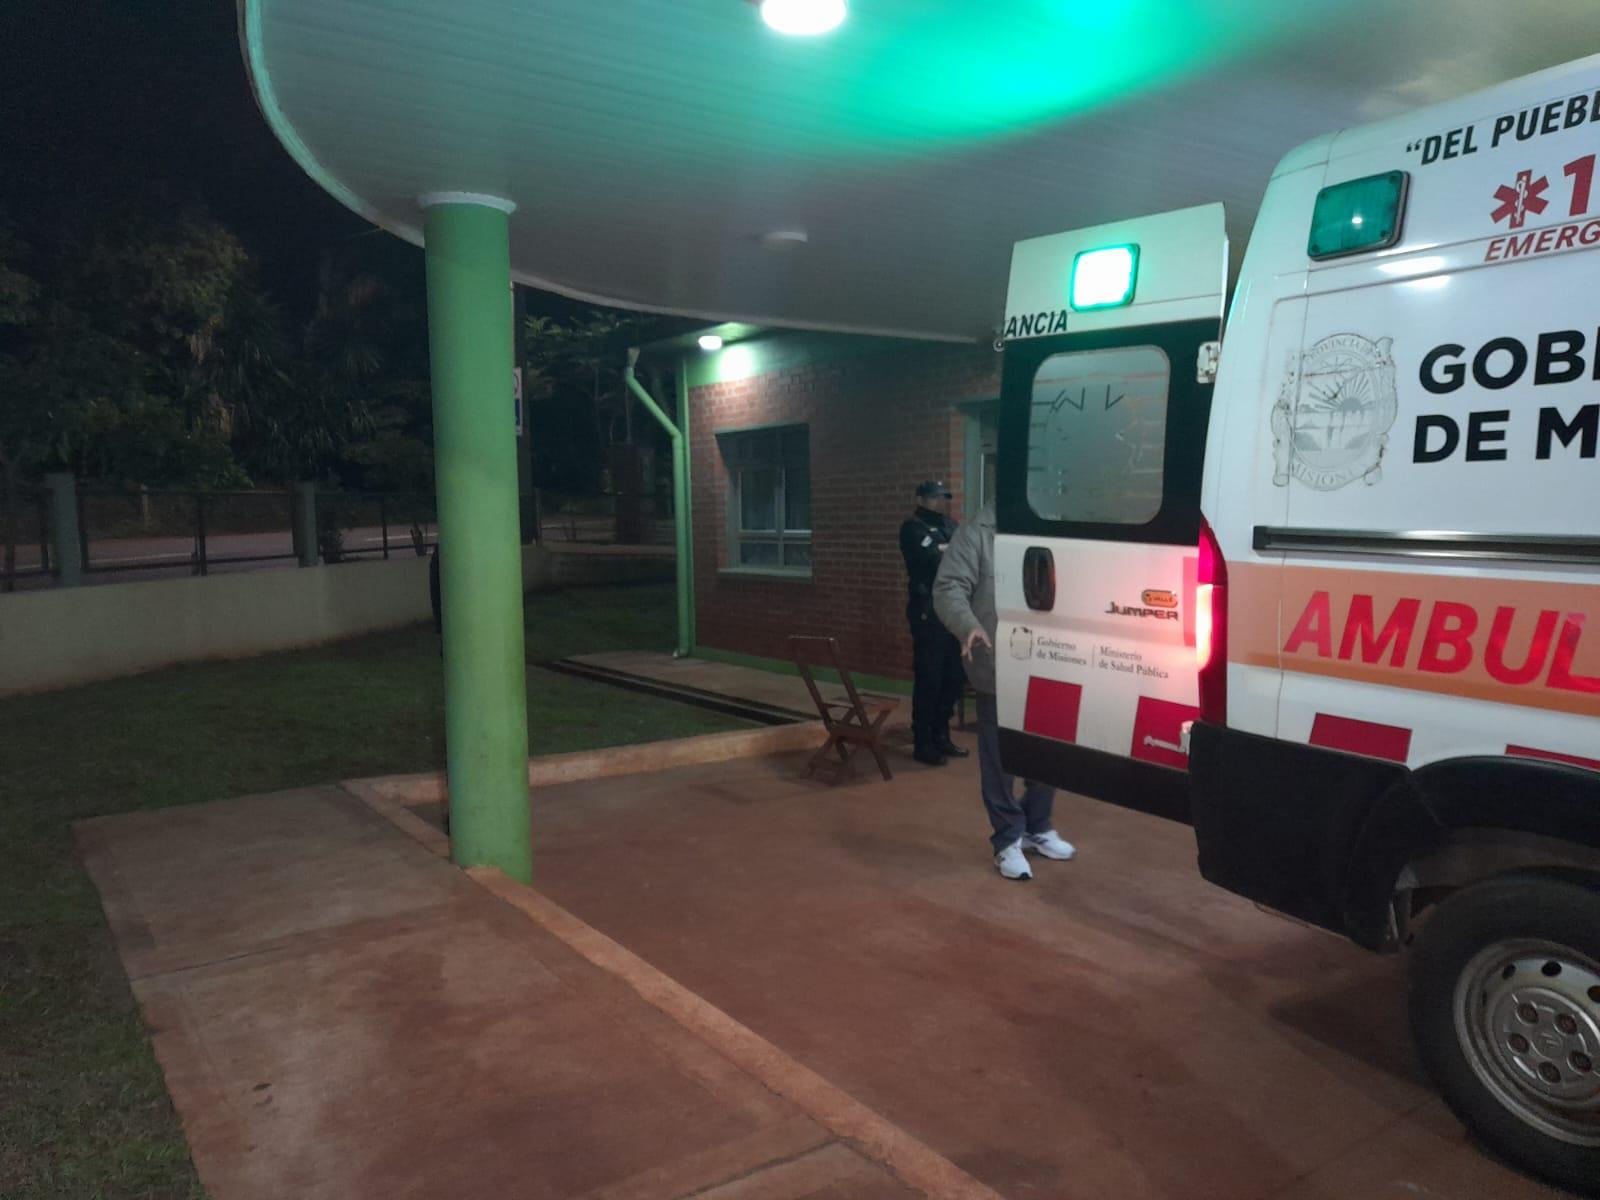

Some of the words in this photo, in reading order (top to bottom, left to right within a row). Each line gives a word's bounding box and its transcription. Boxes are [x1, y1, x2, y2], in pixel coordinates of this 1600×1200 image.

[1563, 154, 1596, 216] 1
[1484, 220, 1600, 262] EMERG
[1005, 309, 1068, 338] ANCIA
[1413, 410, 1510, 464] DE
[1535, 404, 1600, 460] M
[1036, 636, 1077, 651] Gobierno
[1100, 645, 1143, 662] Ministerio
[1283, 590, 1600, 694] AMBUL
[1111, 660, 1134, 674] Salud
